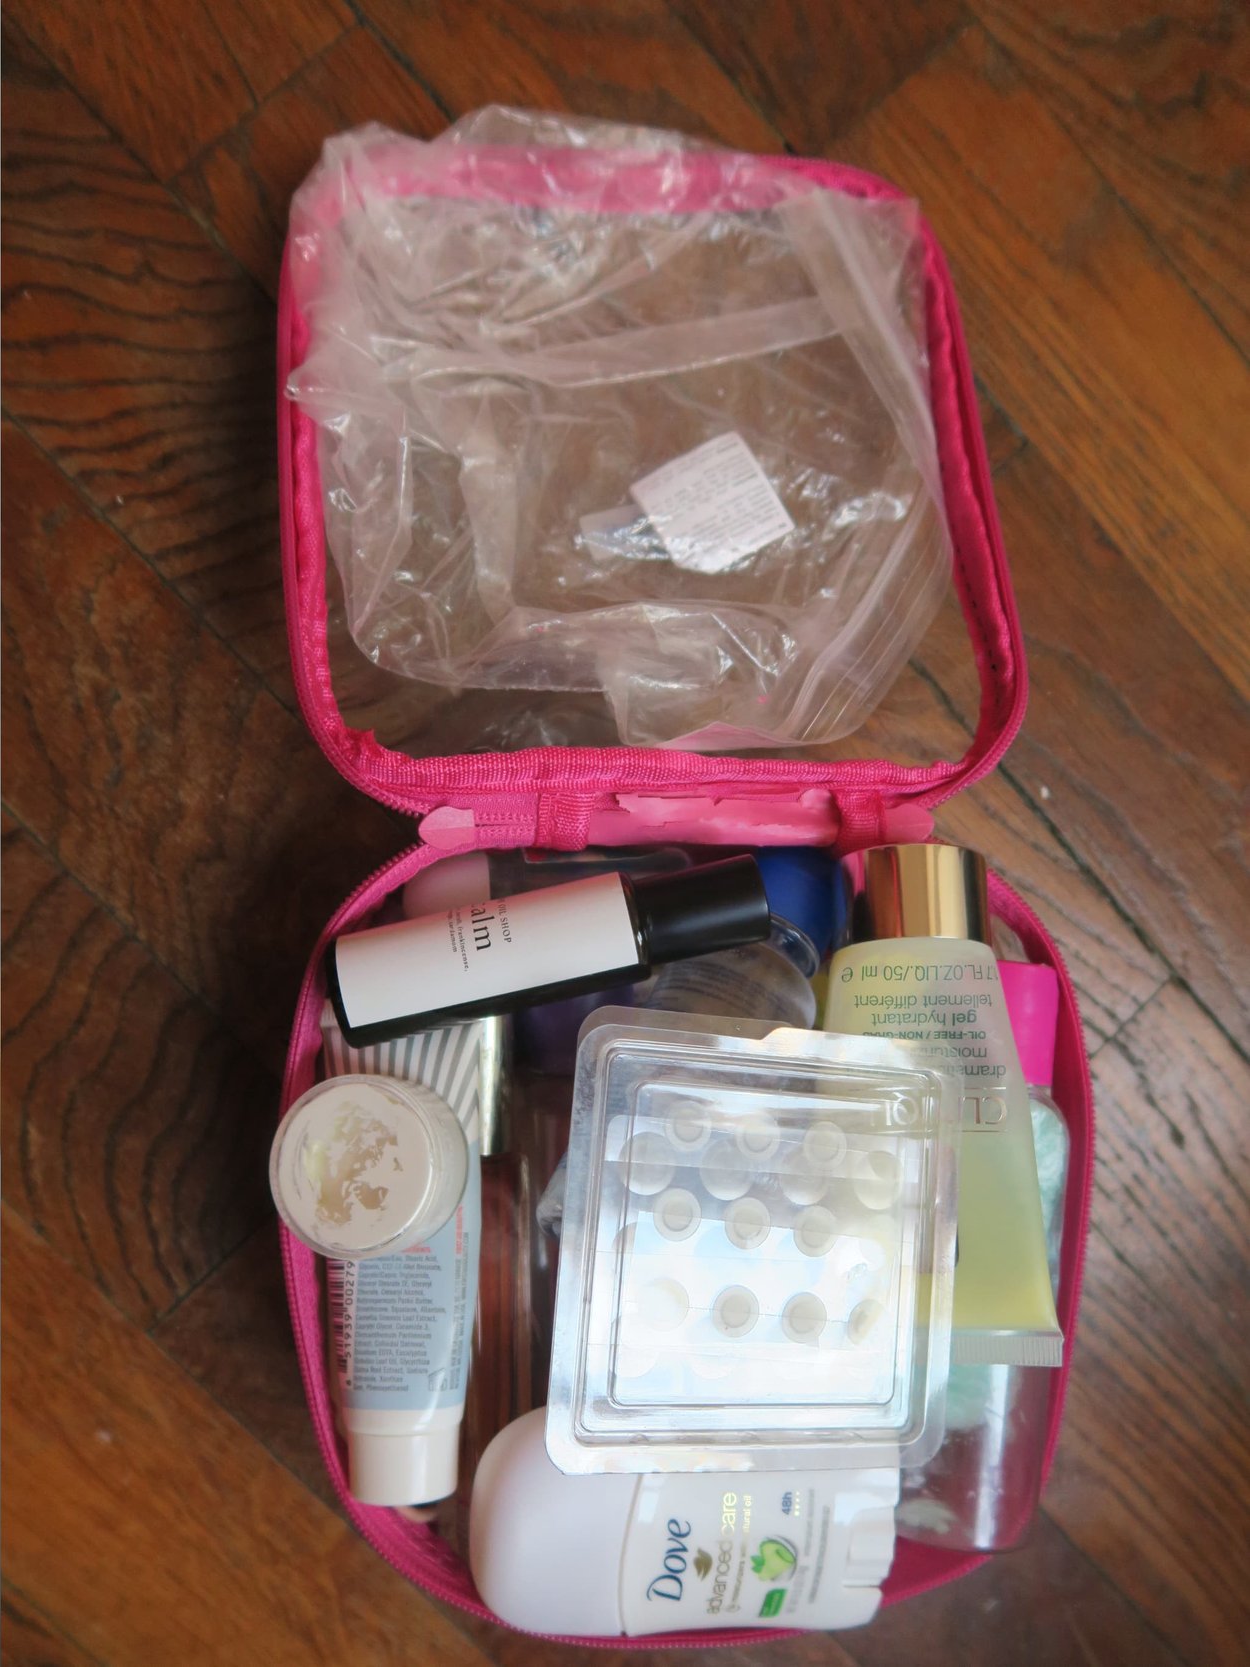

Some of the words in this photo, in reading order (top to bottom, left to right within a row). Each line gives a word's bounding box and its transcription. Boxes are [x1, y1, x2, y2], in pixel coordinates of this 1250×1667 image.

[500, 917, 512, 943] SHOP
[861, 965, 878, 981] ml
[854, 994, 917, 1009] différent
[923, 994, 992, 1007] tellement
[871, 1009, 946, 1026] hydratant
[952, 1009, 977, 1026] gel
[934, 1031, 986, 1040] OIL-FREE
[345, 1261, 356, 1306] 00279
[344, 1314, 353, 1359] 51939
[781, 1491, 793, 1515] 48h
[646, 1518, 692, 1602] Dove
[706, 1540, 734, 1615] advanced
[721, 1491, 737, 1537] care
